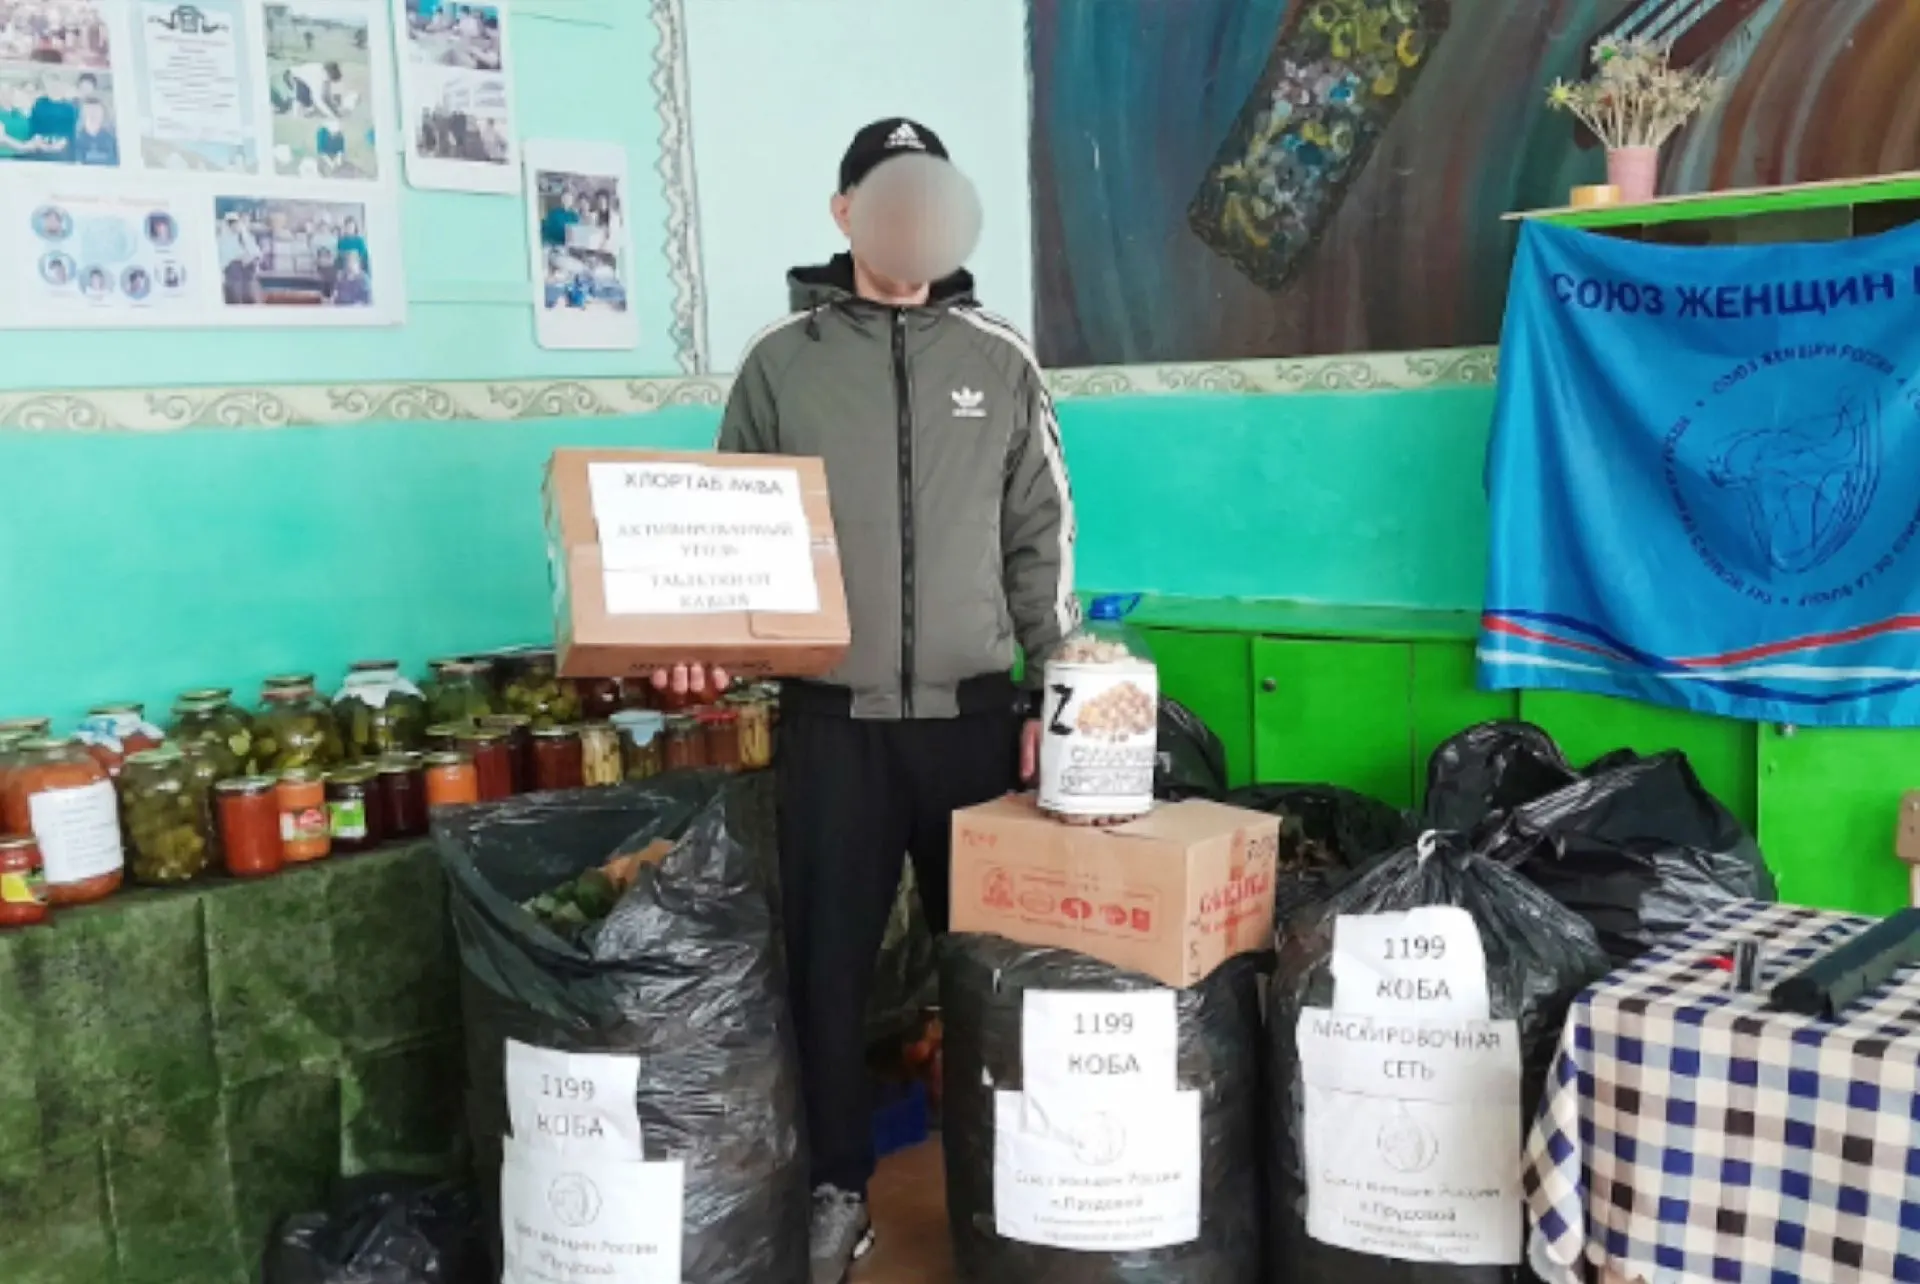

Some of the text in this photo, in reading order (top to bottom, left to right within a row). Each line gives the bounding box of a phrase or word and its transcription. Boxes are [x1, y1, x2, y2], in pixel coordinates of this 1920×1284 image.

[1550, 273, 1664, 315] СОЮЗ
[1675, 272, 1896, 319] ЖЕНЩИН
[624, 471, 723, 491] ХЛОРТАБ
[1048, 684, 1073, 736] Z
[1383, 935, 1447, 960] 1199
[1376, 978, 1452, 1000] КОБА
[1073, 1012, 1133, 1034] 1199
[1313, 1020, 1501, 1049] МАСКИРОВОЧНАЯ
[1068, 1053, 1140, 1075] КОБА
[1383, 1060, 1436, 1080] СЕТЬ
[541, 1073, 595, 1102] 1199
[537, 1113, 603, 1137] КОБА
